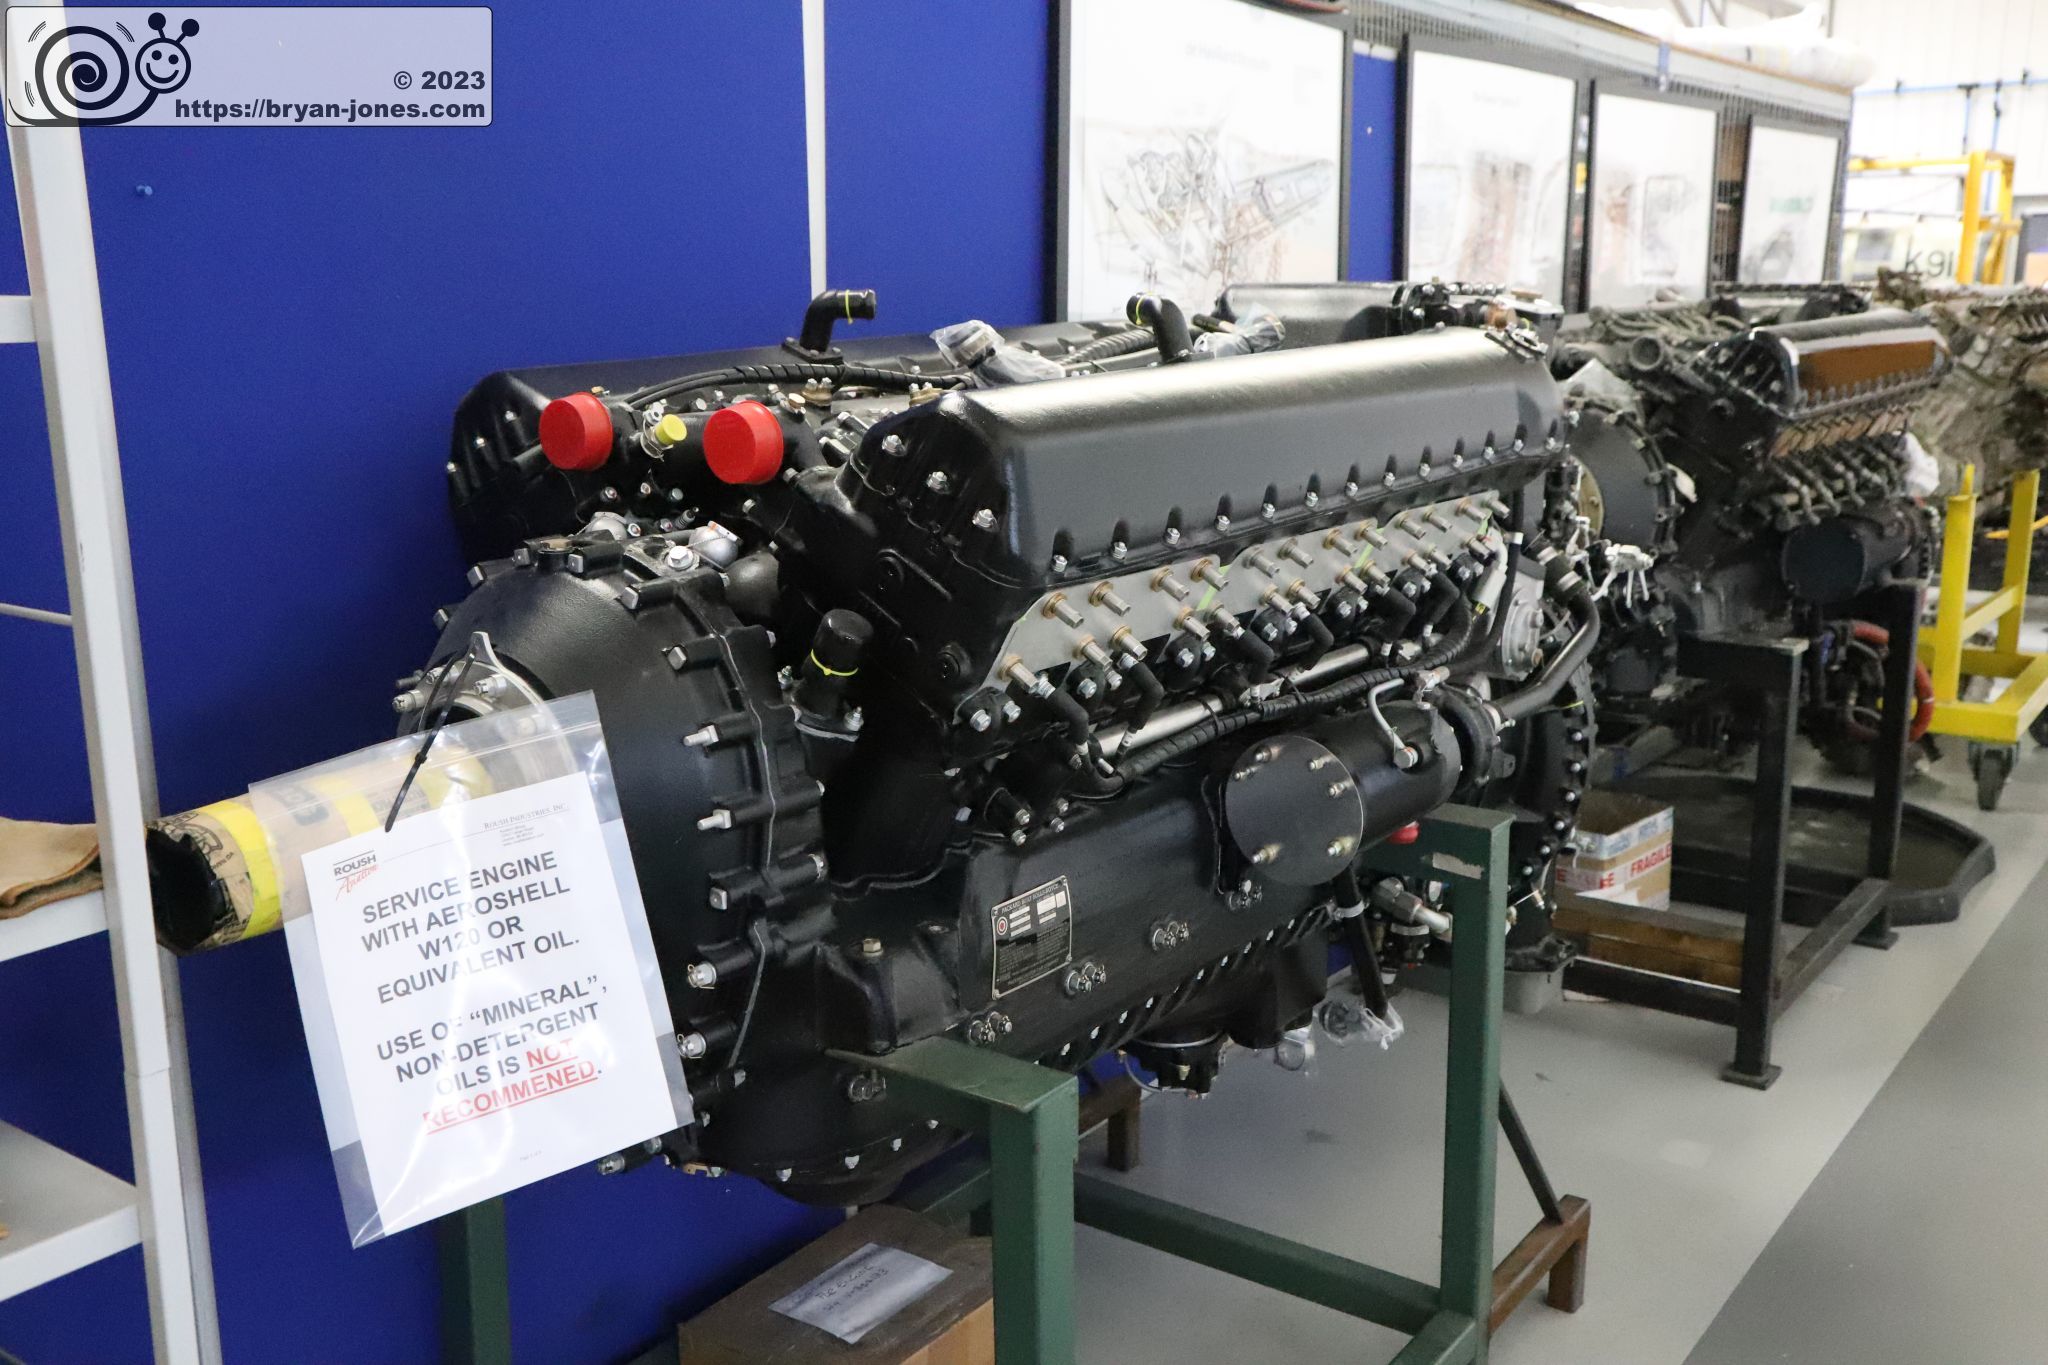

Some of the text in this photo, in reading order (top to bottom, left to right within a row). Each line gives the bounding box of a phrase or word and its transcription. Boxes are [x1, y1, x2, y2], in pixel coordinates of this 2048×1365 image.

[334, 854, 376, 876] ROUSH
[362, 851, 557, 924] SERVICE ENGINE
[1630, 842, 1672, 877] FRAGILE
[361, 877, 570, 952] WITH AEROSHELL
[417, 915, 524, 960] W120 OR
[377, 930, 579, 1004] EQUIVALENT OIL.
[377, 1029, 425, 1061] USE
[396, 1002, 599, 1083] NON-DETERGENT
[436, 1038, 578, 1096] OILS IS NOT
[421, 1060, 602, 1131] RECOMMENED.
